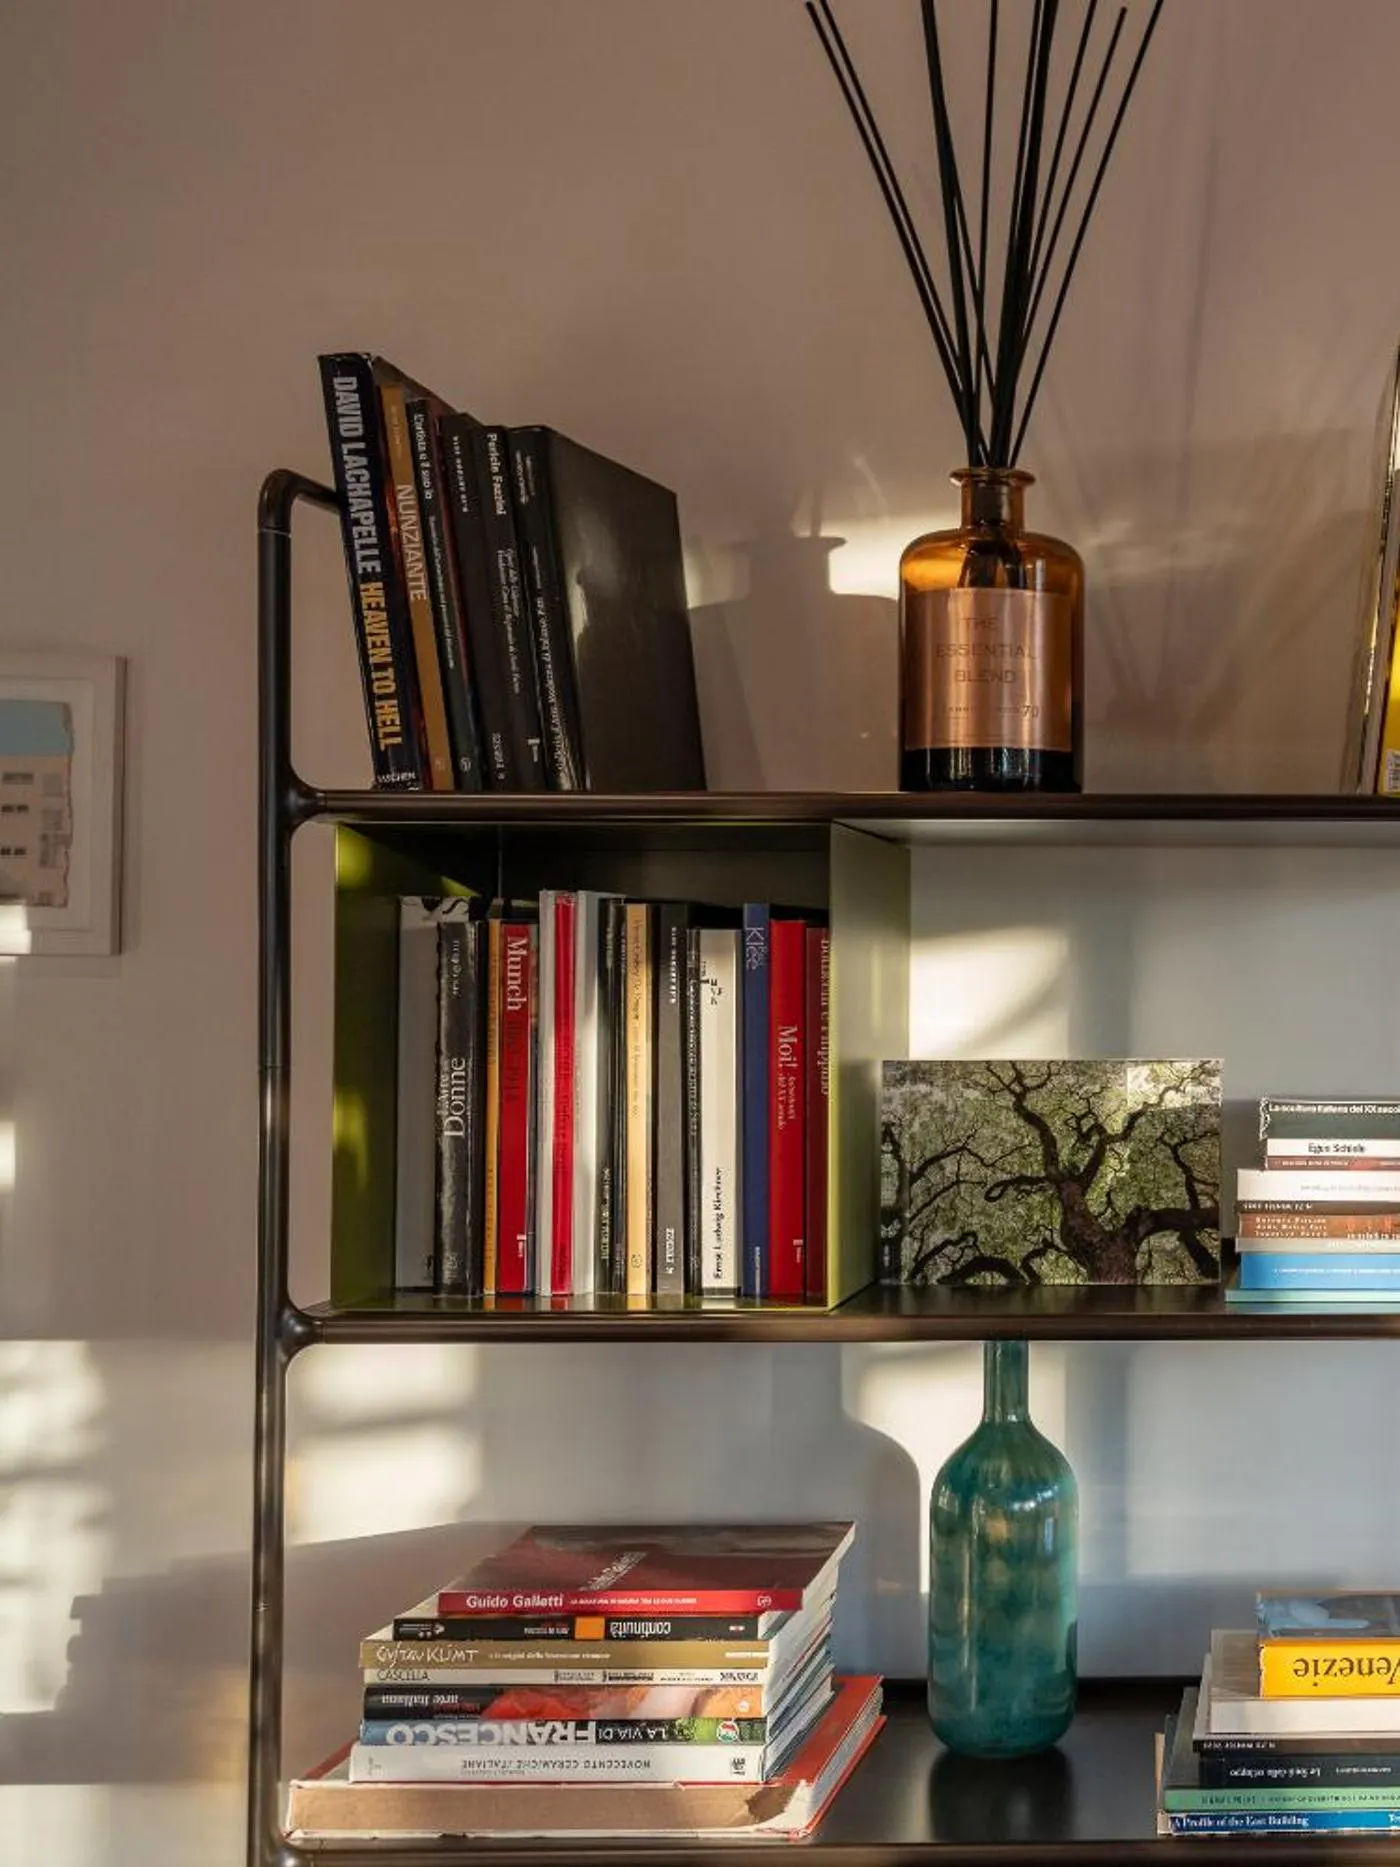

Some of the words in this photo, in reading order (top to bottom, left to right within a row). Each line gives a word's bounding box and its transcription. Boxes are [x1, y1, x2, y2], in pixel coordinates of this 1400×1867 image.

[333, 376, 364, 438] DAVID
[492, 475, 507, 516] Fazzini
[340, 442, 382, 575] LACHAPELLE
[396, 484, 428, 601] NUNZIANTE
[360, 581, 394, 668] HEAVEN
[935, 642, 1036, 659] ESSENTIAL
[371, 669, 397, 695] TO
[954, 669, 1016, 684] BLEND
[375, 700, 403, 751] HELL
[745, 927, 765, 970] Klee
[507, 936, 527, 1011] Munch
[778, 1026, 799, 1069] Moi!
[444, 1057, 466, 1137] Donne
[1349, 1104, 1363, 1114] del
[1364, 1104, 1377, 1114] XX
[1333, 1143, 1366, 1154] Schiele
[466, 1595, 508, 1609] Guido
[512, 1594, 564, 1608] Galletti
[610, 1621, 672, 1638] continuità
[427, 1645, 479, 1663] KLIMT
[377, 1669, 431, 1681] CASCELLA
[381, 1694, 430, 1708] italiana
[432, 1694, 459, 1705] arte
[386, 1721, 597, 1745] FRANCESCO
[598, 1727, 614, 1739] DI
[617, 1727, 643, 1739] VIA
[647, 1727, 666, 1739] LA
[460, 1759, 513, 1770] ITALIANE
[515, 1759, 580, 1770] CERAMICHE
[583, 1759, 651, 1770] NOVECENTO
[1183, 1817, 1213, 1828] Profile
[1216, 1817, 1227, 1827] of
[1268, 1815, 1309, 1827] Building
